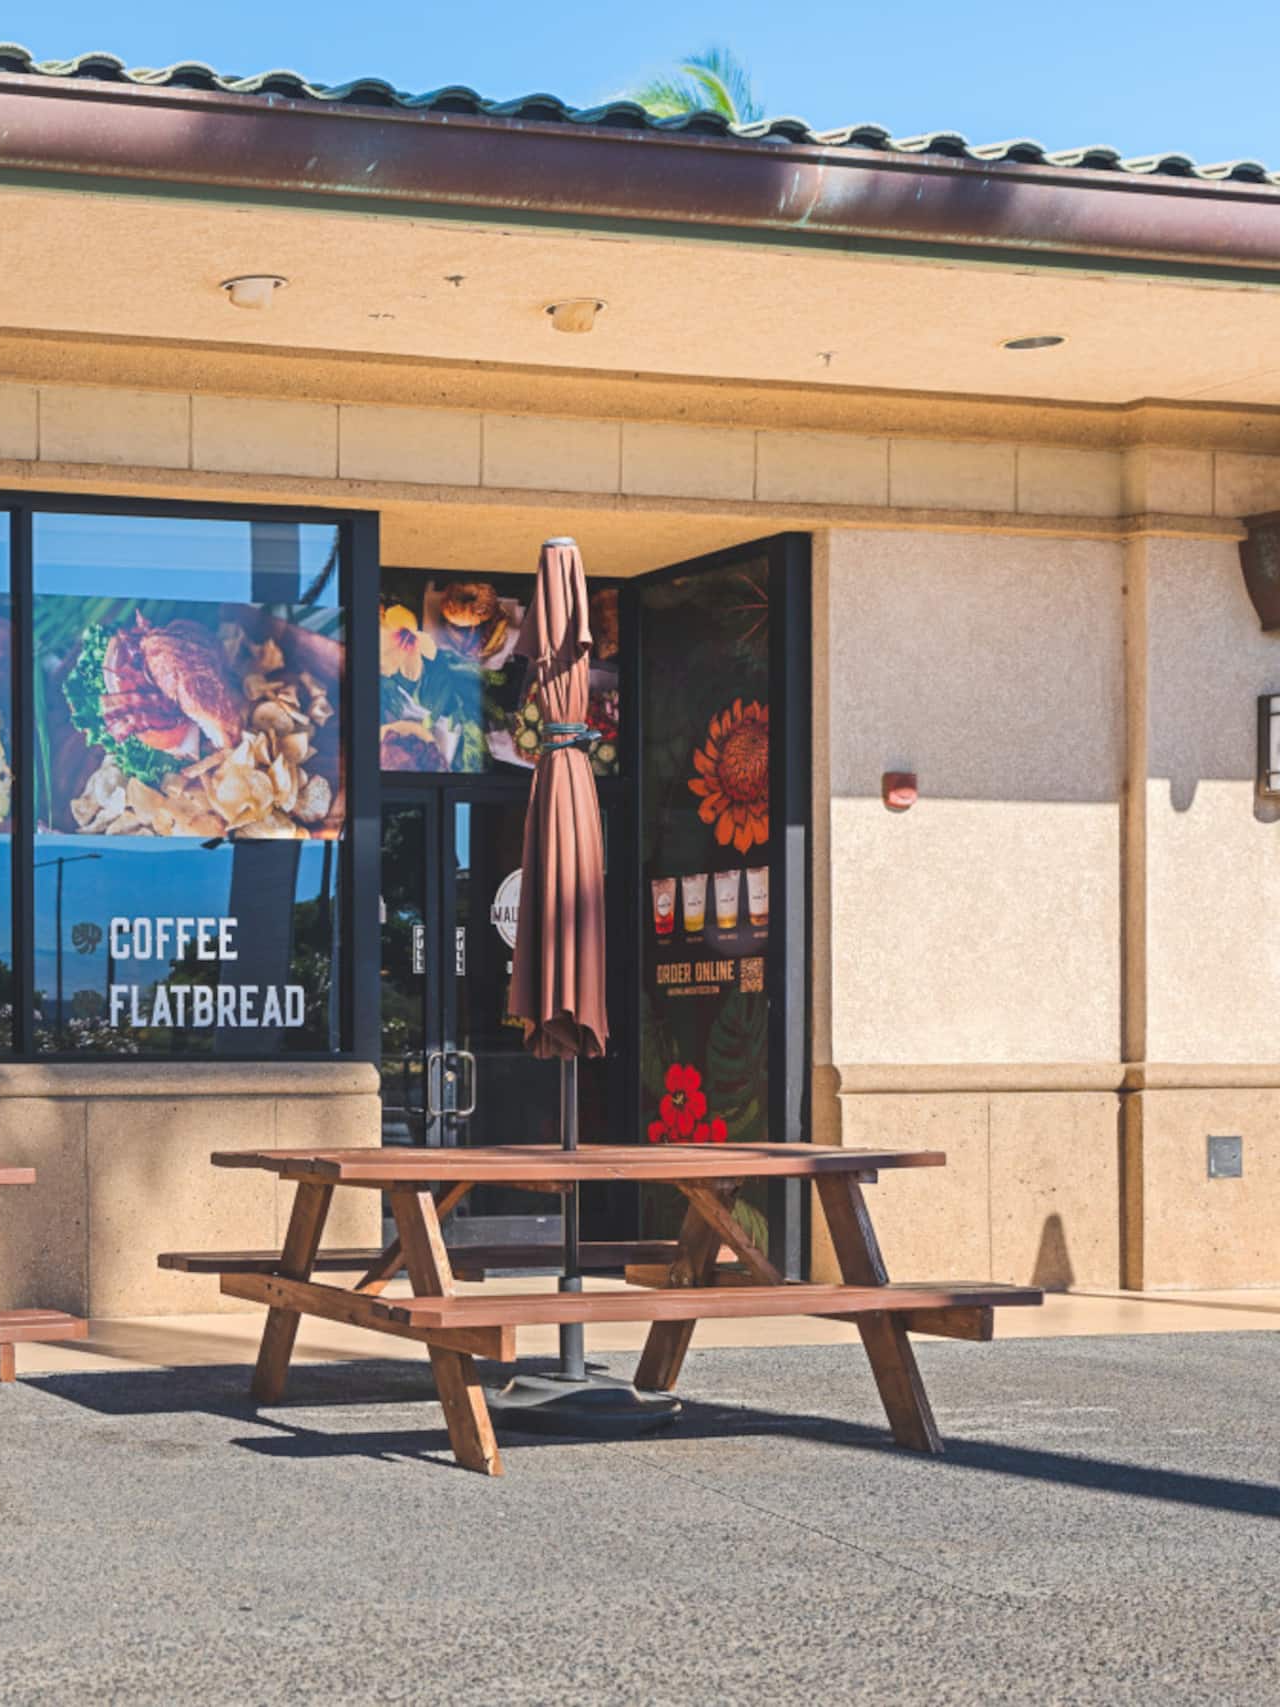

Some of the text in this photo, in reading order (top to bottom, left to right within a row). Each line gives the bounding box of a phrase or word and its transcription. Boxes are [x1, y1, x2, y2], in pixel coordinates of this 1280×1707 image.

[492, 905, 520, 922] MAU
[110, 917, 238, 961] COFFEE
[415, 928, 425, 970] PULL
[455, 929, 464, 972] PULL
[657, 960, 735, 984] ORDER ONLINE
[110, 984, 305, 1028] FLATBREAD
